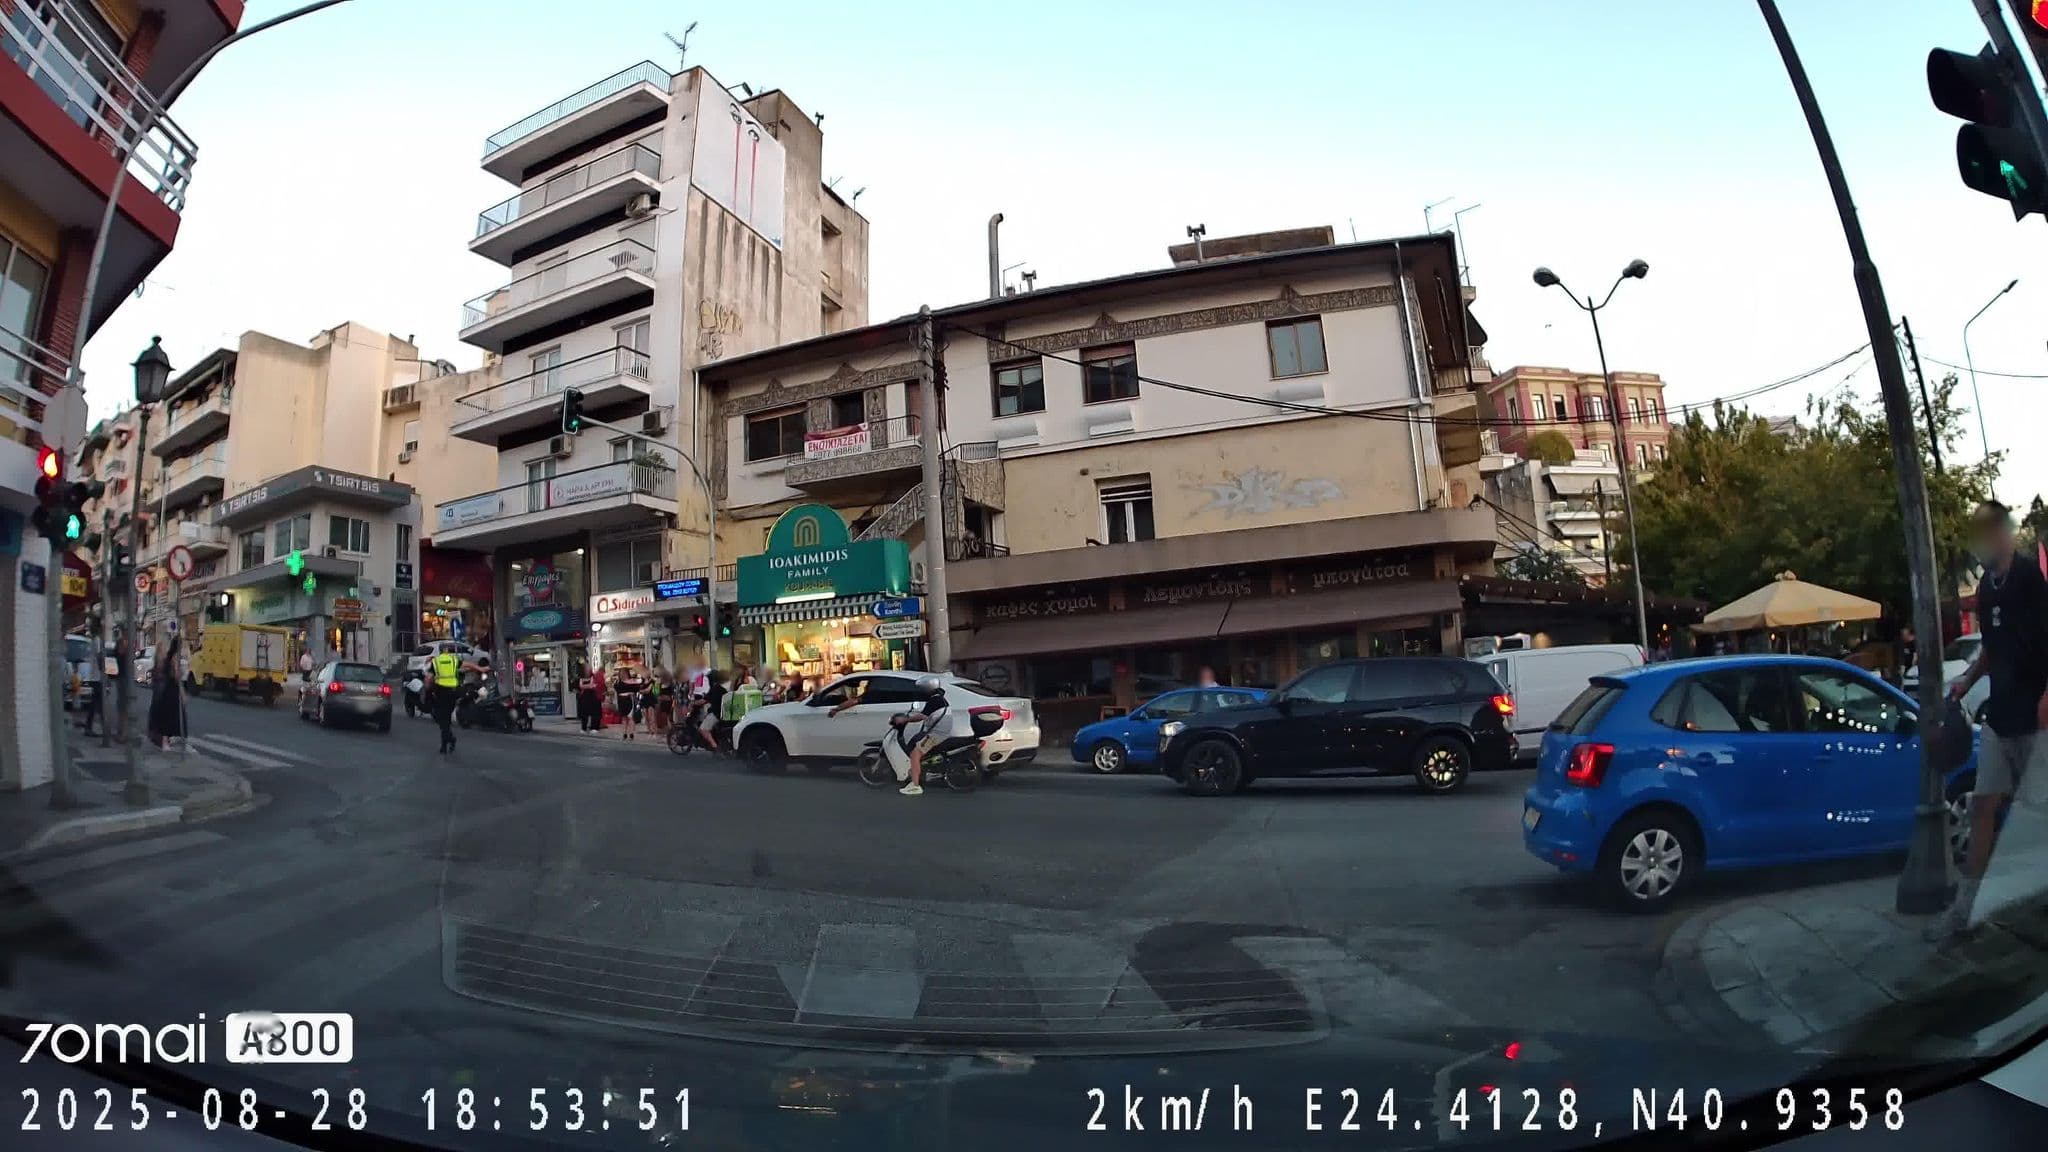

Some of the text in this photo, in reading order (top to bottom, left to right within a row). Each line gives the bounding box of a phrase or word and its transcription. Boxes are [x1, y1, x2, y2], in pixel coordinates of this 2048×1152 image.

[808, 432, 868, 452] ΕΝΟΙΚΙΑΖΕΤΑΙ
[328, 473, 380, 493] TSIRTSIS
[229, 486, 268, 512] TSIRTSIS
[769, 548, 849, 569] IOAKIMIDIS
[787, 566, 829, 579] FAMILY
